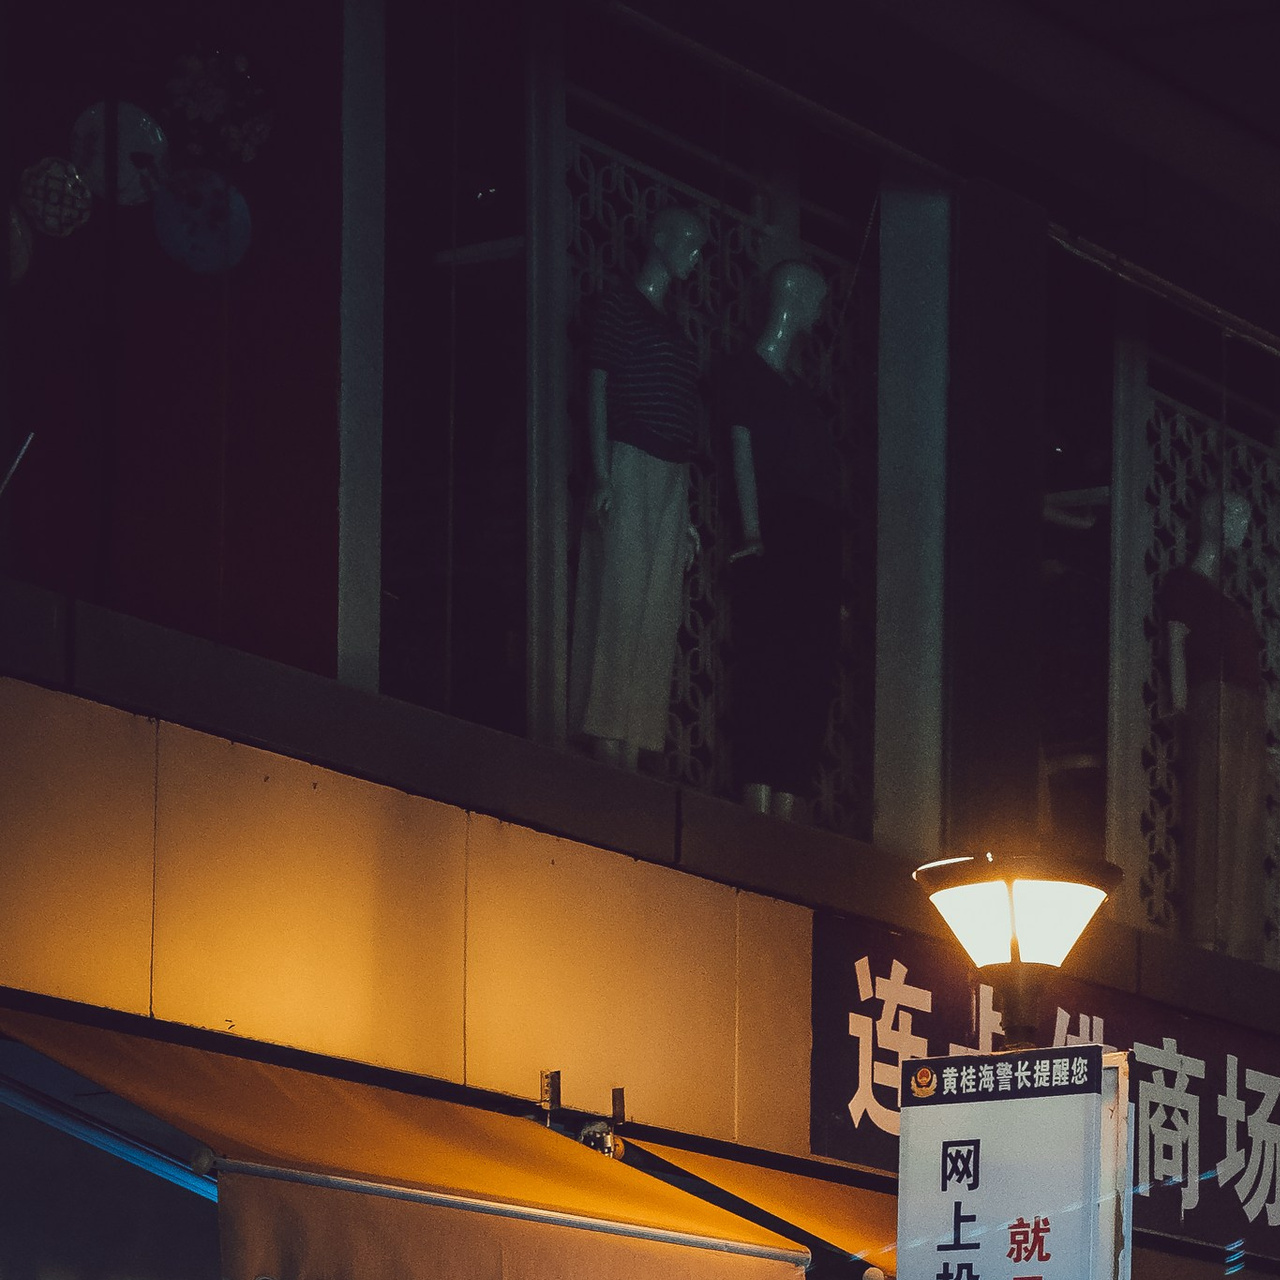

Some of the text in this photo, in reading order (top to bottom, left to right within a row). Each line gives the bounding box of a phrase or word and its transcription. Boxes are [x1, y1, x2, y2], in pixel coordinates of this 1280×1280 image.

[942, 1056, 1089, 1095] 黄桂海警长提醒您
